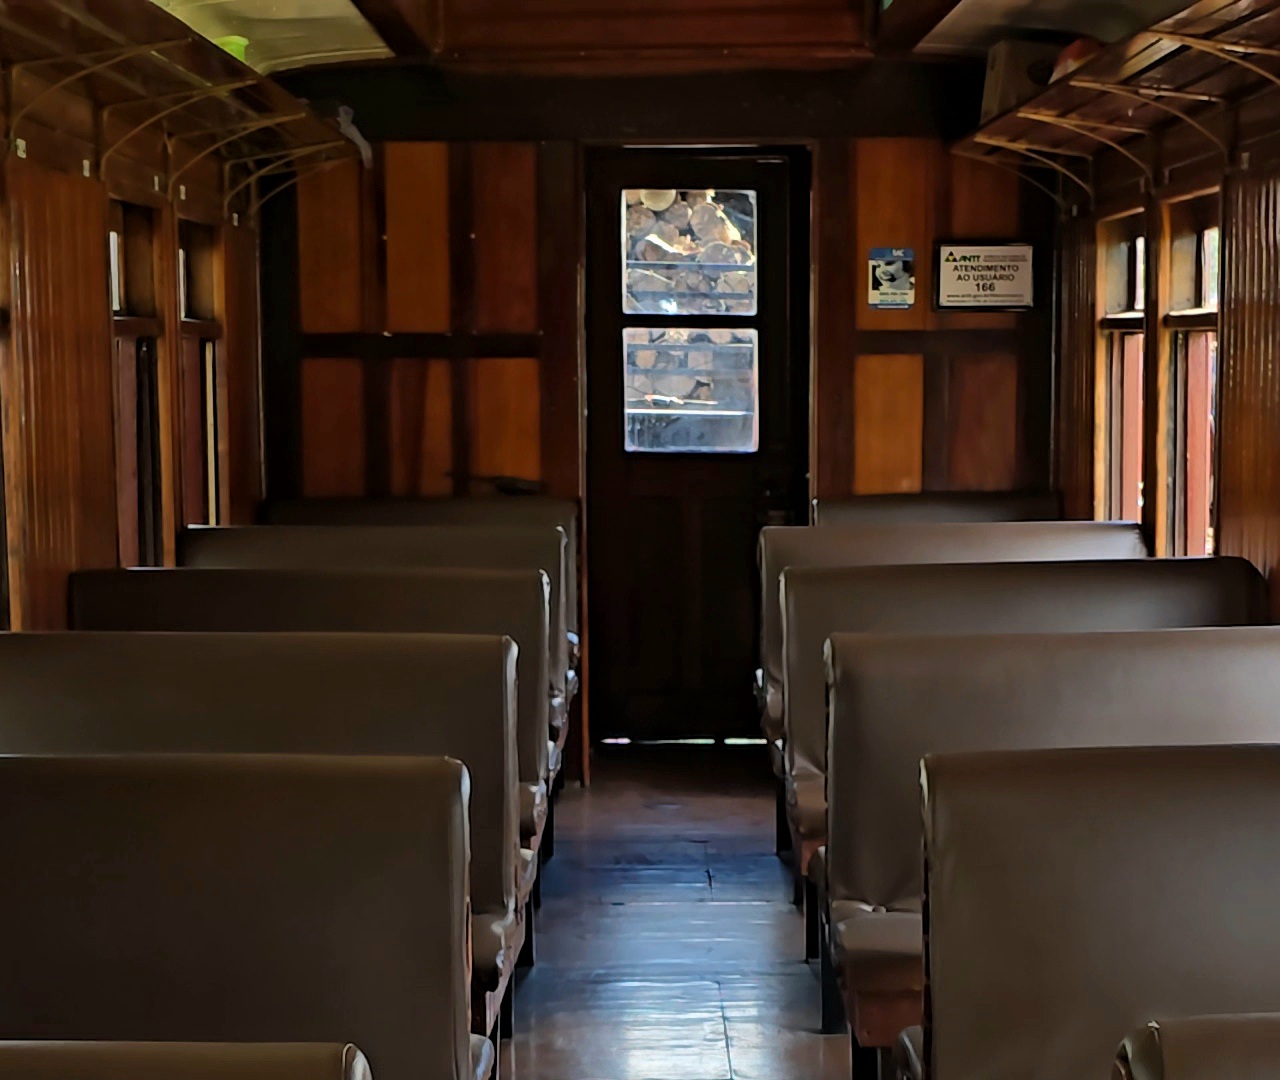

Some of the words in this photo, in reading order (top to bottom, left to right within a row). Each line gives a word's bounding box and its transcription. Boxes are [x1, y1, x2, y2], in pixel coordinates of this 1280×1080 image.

[953, 264, 1019, 272] ATENDIMENTO
[973, 273, 1015, 281] USUÁRIO
[975, 282, 995, 292] 166
